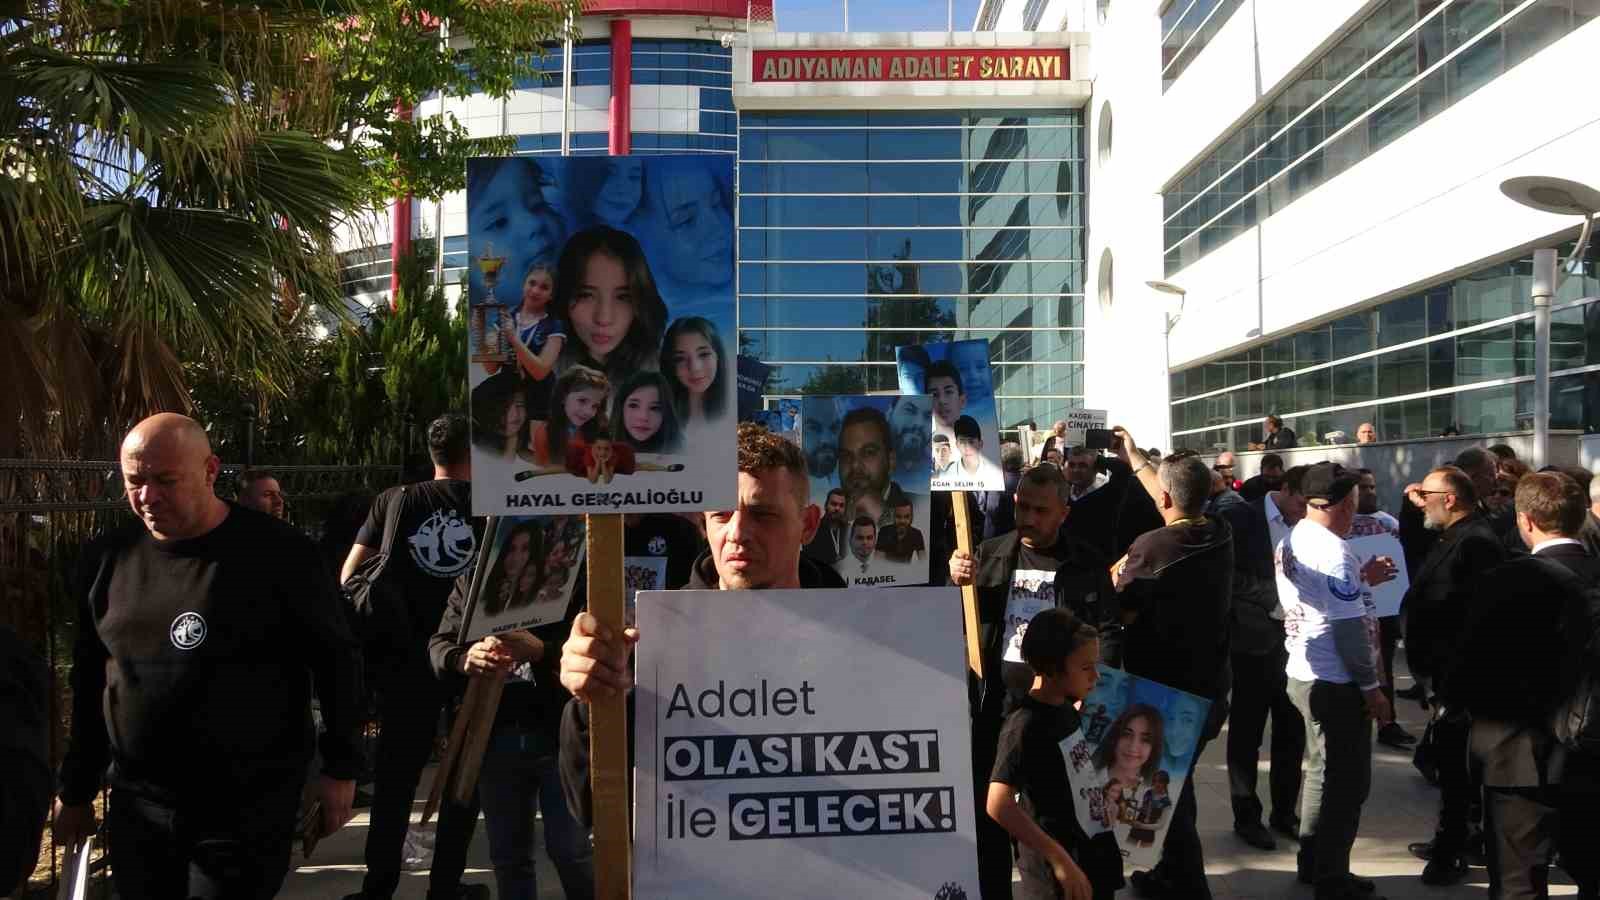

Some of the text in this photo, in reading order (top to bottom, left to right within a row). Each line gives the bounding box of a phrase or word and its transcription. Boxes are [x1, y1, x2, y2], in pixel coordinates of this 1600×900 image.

[762, 55, 1061, 80] ADIYAMAN ADALET SARAYI
[506, 494, 566, 507] HAYAL
[665, 680, 816, 719] Adalet
[665, 733, 937, 777] OLASI KAST
[731, 790, 954, 837] GELECEK!
